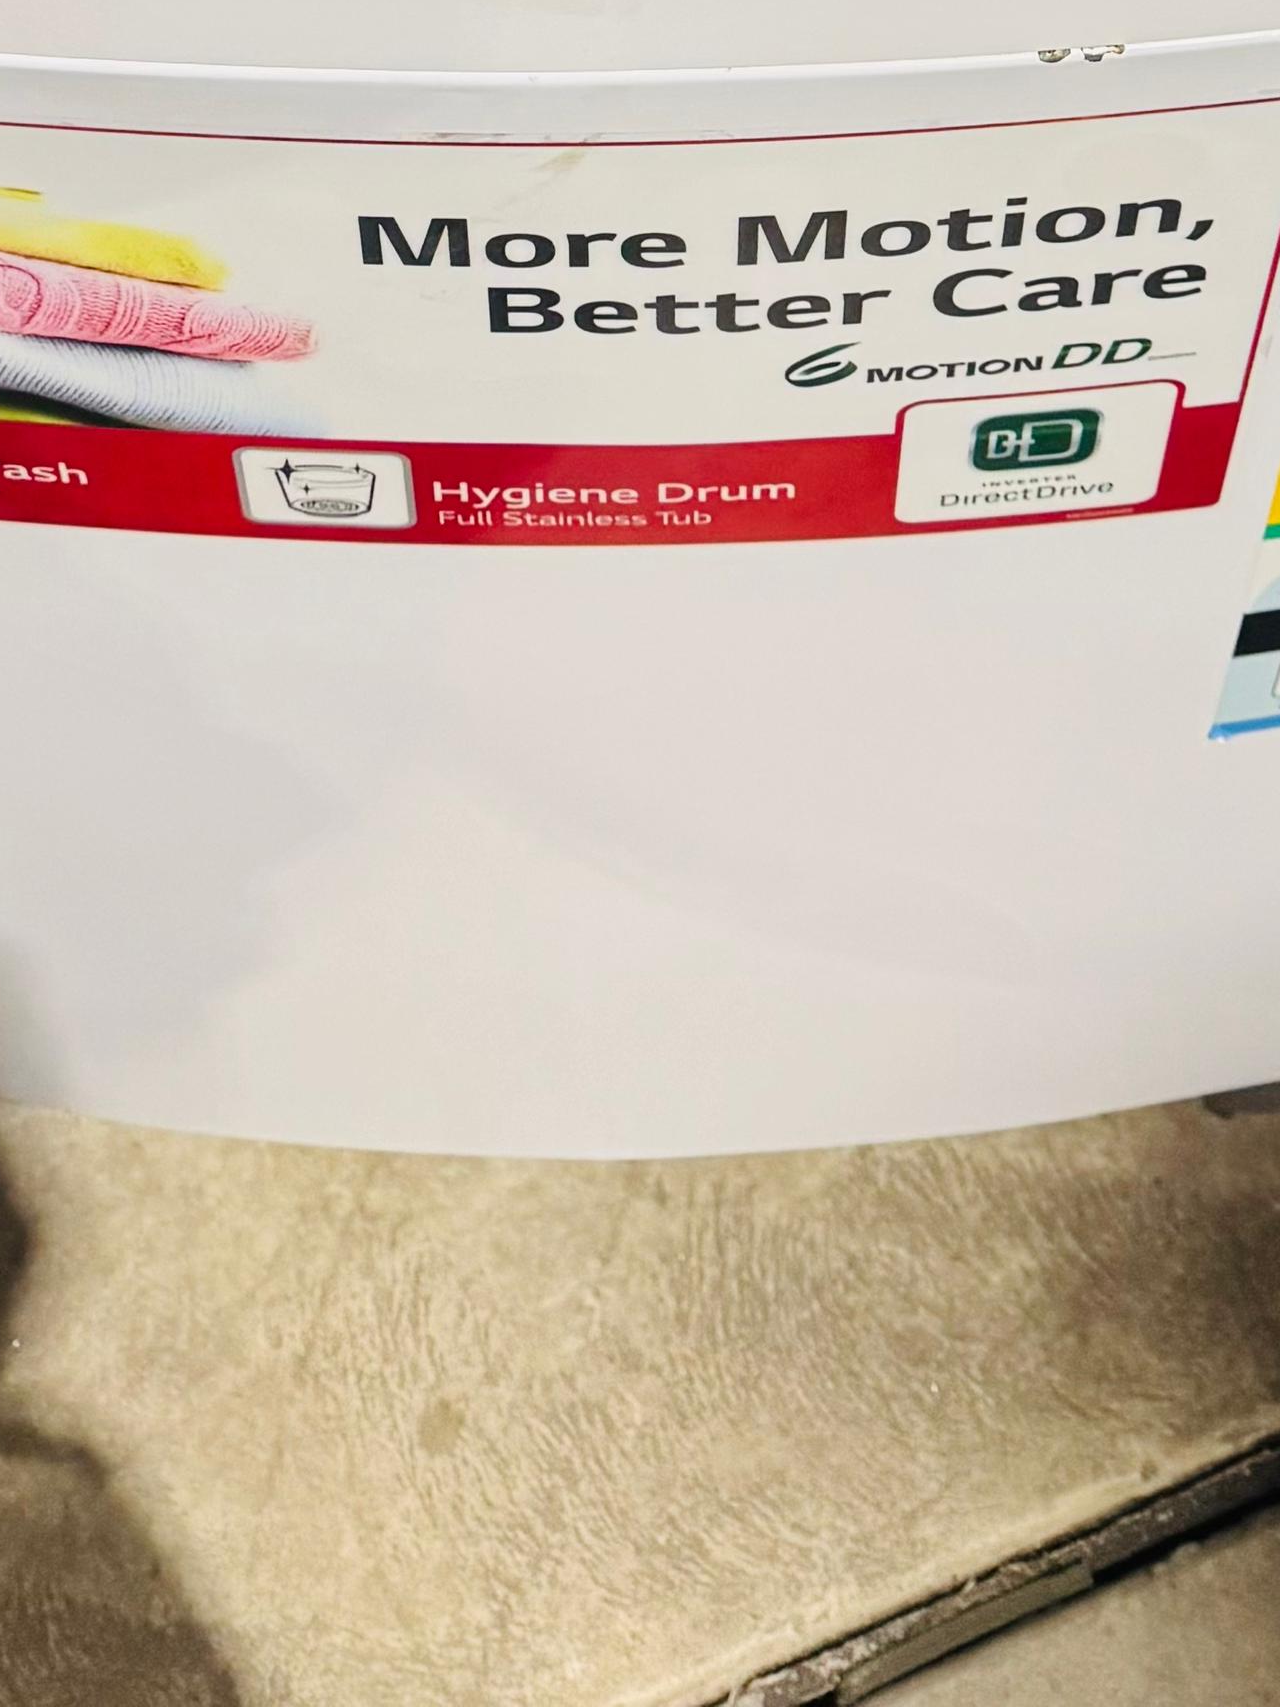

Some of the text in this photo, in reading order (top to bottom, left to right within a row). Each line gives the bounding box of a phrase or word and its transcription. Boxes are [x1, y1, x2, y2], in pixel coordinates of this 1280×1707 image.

[357, 195, 1215, 269] More Motion,
[486, 263, 1210, 336] Better Care
[866, 355, 1044, 384] MOTION
[432, 481, 796, 508] Hygiene Drum
[982, 474, 1076, 488] INVERTER
[438, 510, 712, 527] Full Stainless Tub
